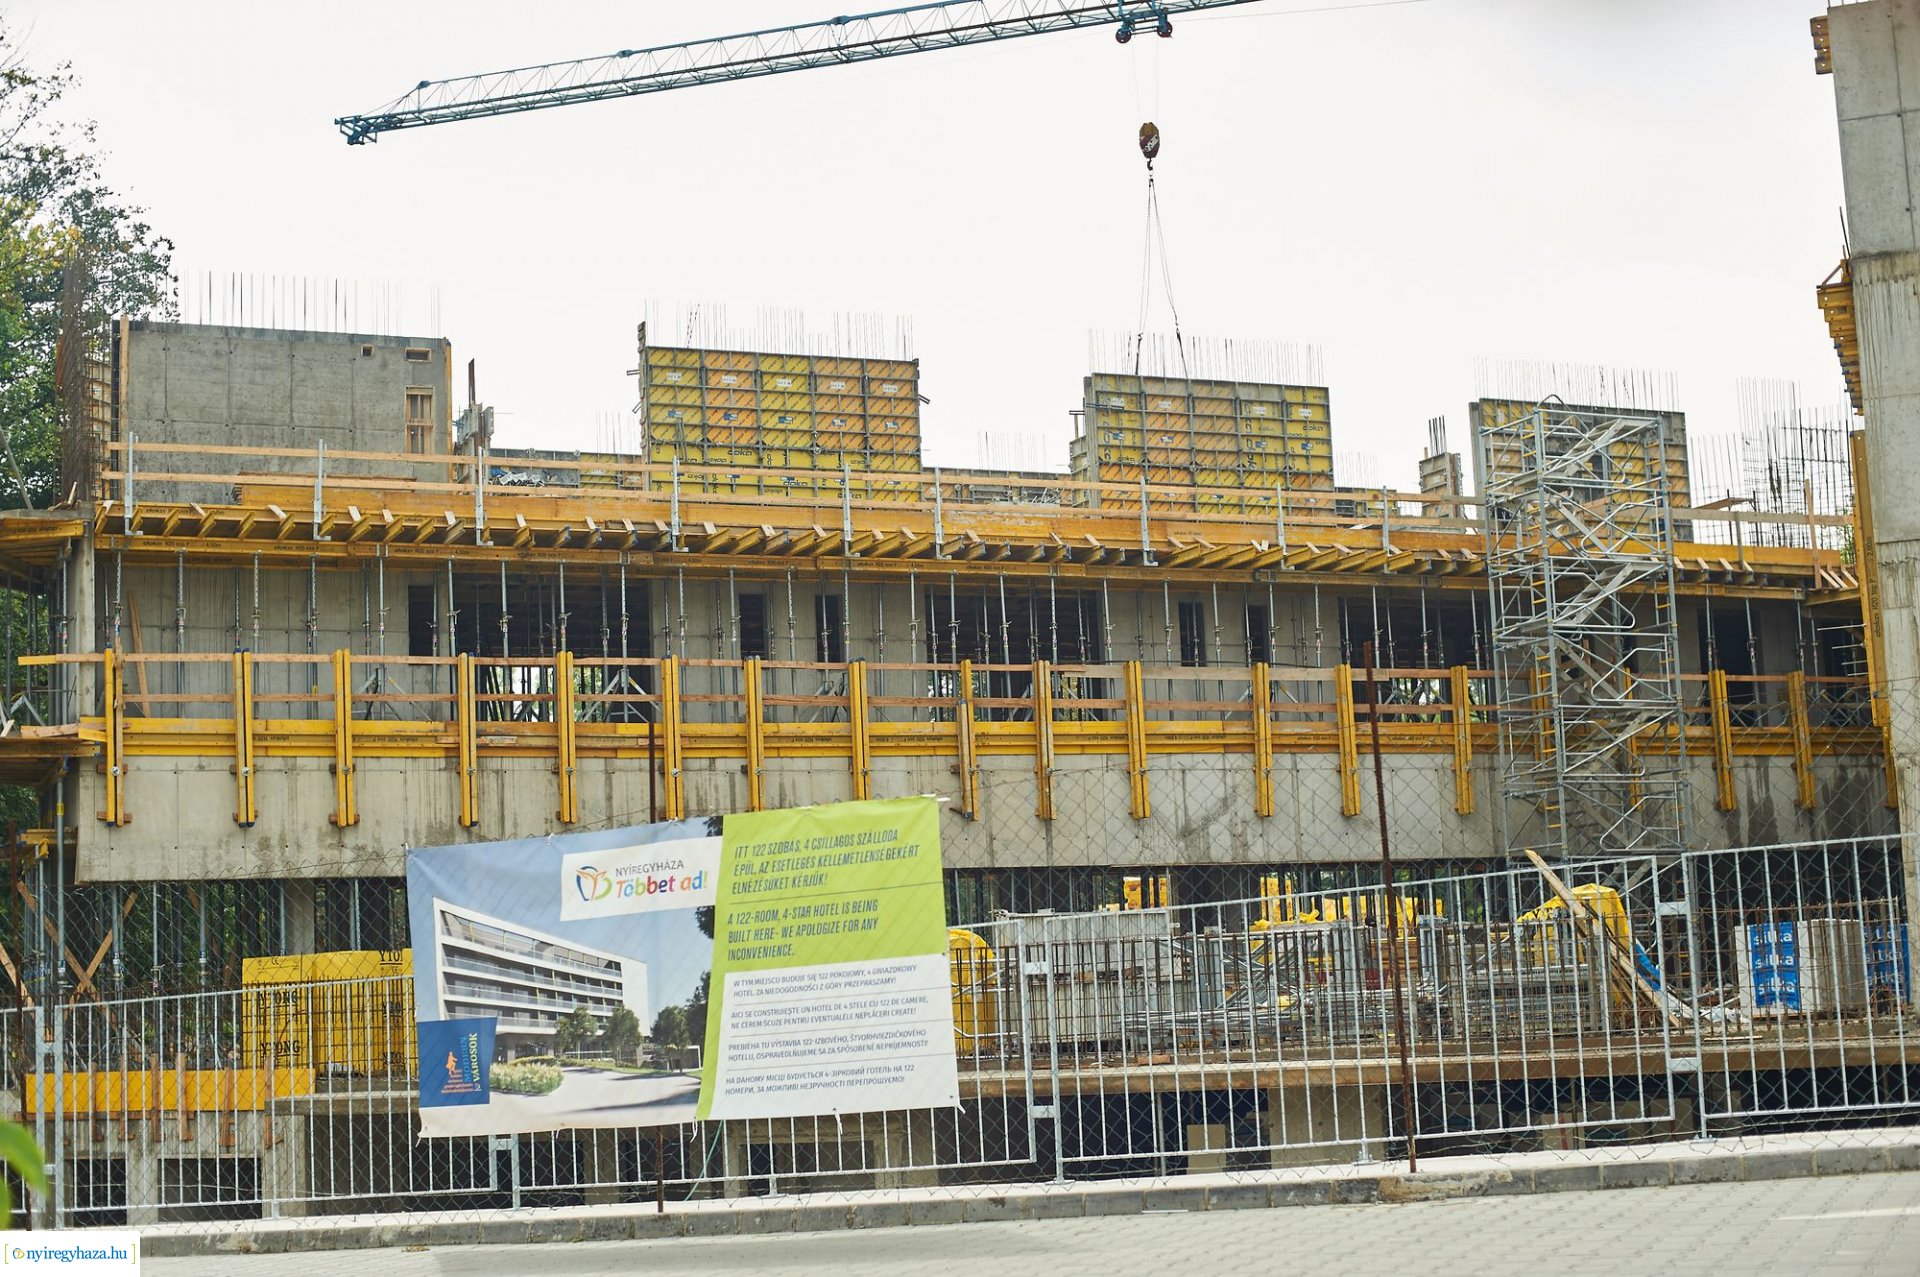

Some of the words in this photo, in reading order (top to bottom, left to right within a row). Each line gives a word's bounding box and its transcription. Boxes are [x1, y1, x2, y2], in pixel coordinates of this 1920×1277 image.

[735, 846, 748, 859] ITT
[752, 844, 766, 857] 122
[804, 838, 809, 850] 4
[812, 834, 854, 850] CSILLAGOS
[856, 829, 898, 846] SZÁLLODA
[616, 859, 684, 877] NYÍREGYHÁZA
[758, 861, 769, 874] AZ
[772, 856, 816, 872] ESETLEGES
[616, 876, 676, 898] Többet
[680, 870, 708, 891] ad!
[728, 913, 733, 926] A
[783, 905, 811, 920] 4-STAR
[813, 902, 839, 918] HOTEL
[842, 902, 850, 914] IS
[852, 899, 878, 913] BEING
[728, 930, 751, 944] BUILT
[782, 925, 793, 938] WE
[795, 920, 840, 937] APOLOGIZE
[842, 919, 859, 932] FOR
[860, 916, 879, 931] ANY
[379, 950, 402, 962] YTO
[728, 944, 795, 962] INCONVENIENCE.
[753, 976, 780, 985] MIEJSCU
[782, 974, 805, 983] BUDUJE
[819, 972, 828, 980] 122
[872, 964, 917, 975] GWIAZDKOWY
[756, 988, 764, 996] ZA
[731, 1011, 744, 1019] AICI
[812, 1004, 833, 1012] HOTEL
[849, 1001, 867, 1009] STELE
[869, 1000, 879, 1008] CU
[880, 999, 890, 1007] 122
[741, 1020, 762, 1029] CEREM
[764, 1019, 782, 1027] SCUZE
[784, 1017, 810, 1026] PENTRU
[810, 1012, 853, 1023] EVENTUALELE
[459, 1037, 472, 1082] MODERN
[468, 1032, 480, 1082] VÁROSOK
[827, 1047, 836, 1055] ZA
[866, 1066, 891, 1074] ГОТЕЛЬ
[904, 1064, 915, 1072] 122
